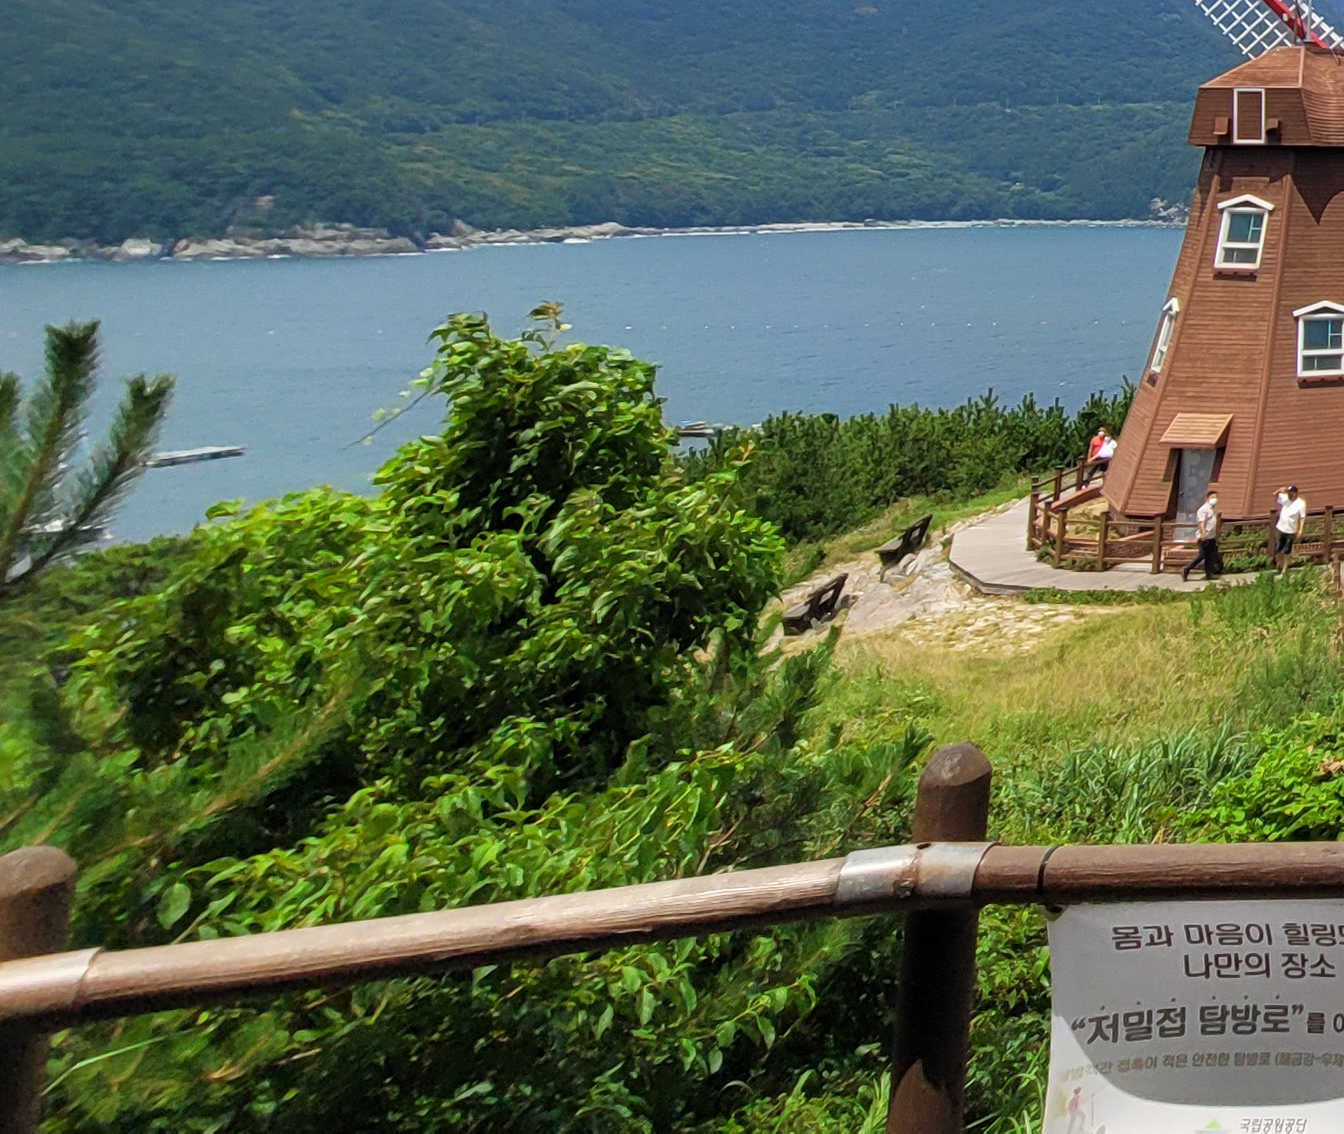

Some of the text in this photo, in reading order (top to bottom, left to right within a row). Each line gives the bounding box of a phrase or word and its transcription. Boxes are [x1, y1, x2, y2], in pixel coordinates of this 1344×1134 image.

[1112, 925, 1174, 950] 몸과
[1184, 923, 1273, 946] 마음이
[1184, 952, 1336, 979] 나만의 장소
[1240, 1117, 1307, 1133] 국립공원공단
